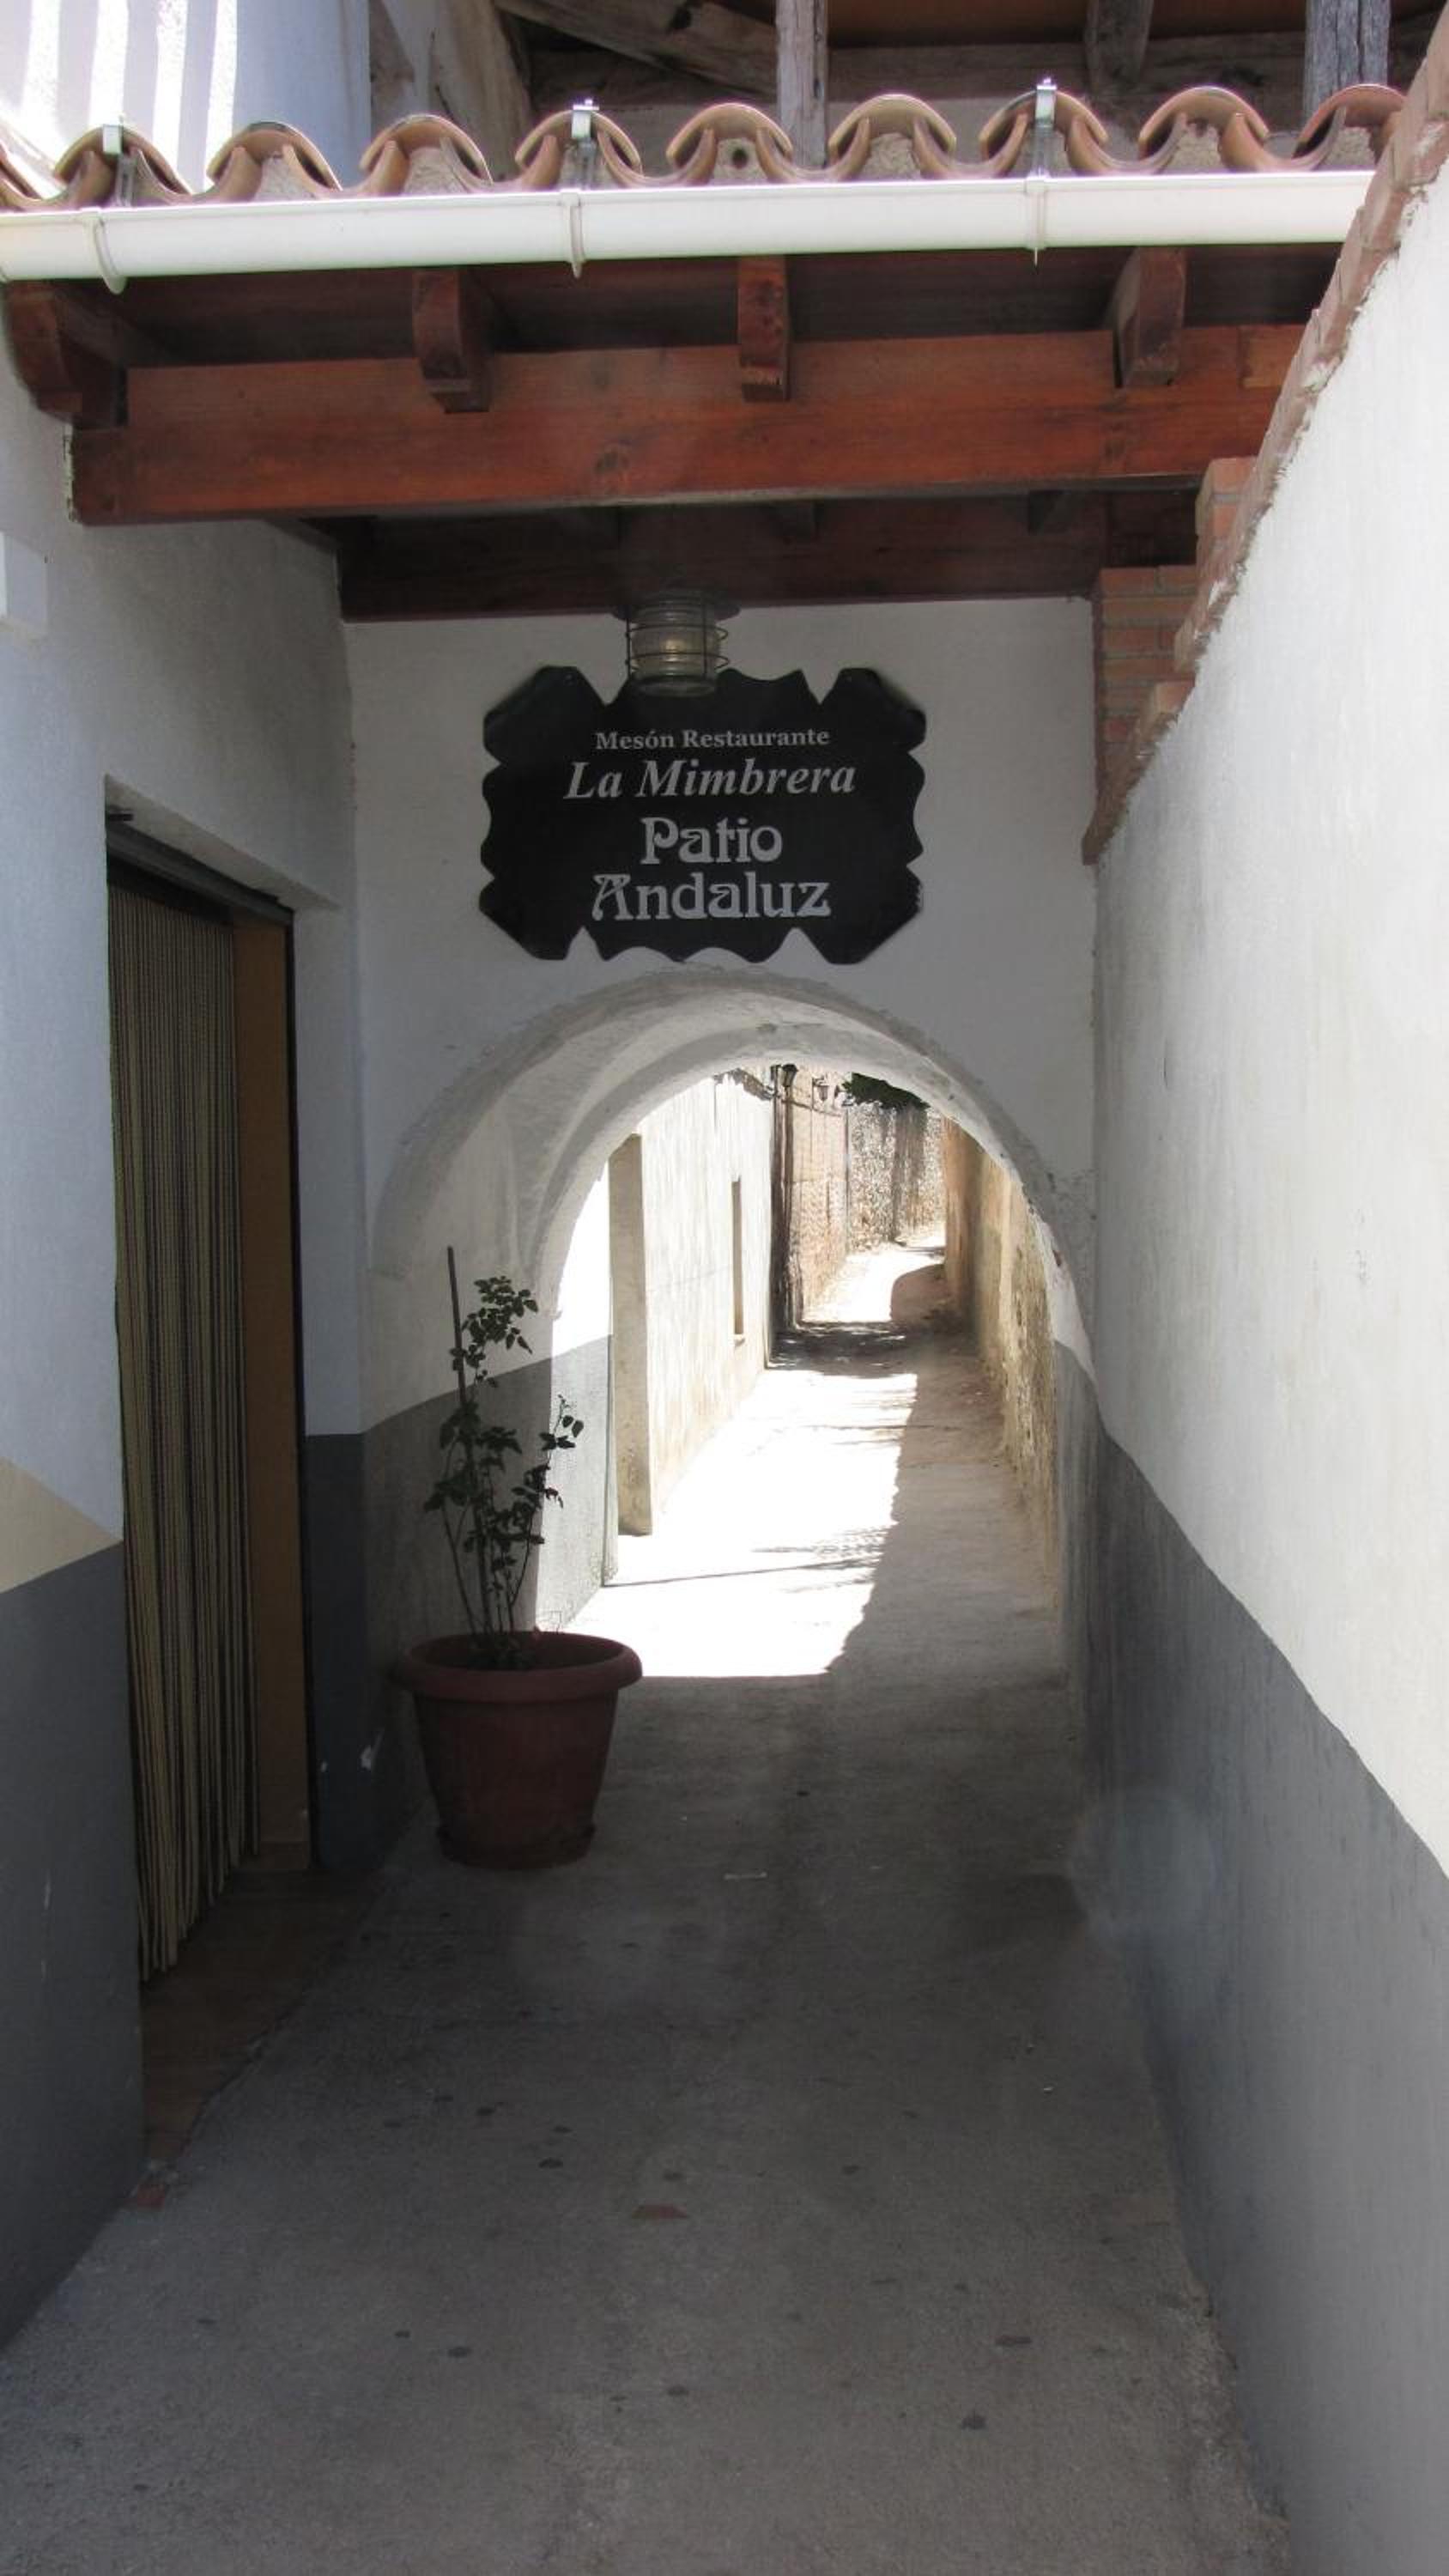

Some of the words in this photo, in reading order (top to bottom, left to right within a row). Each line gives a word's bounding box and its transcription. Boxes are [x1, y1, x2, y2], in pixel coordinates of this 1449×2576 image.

[596, 730, 674, 750] Mesón
[682, 729, 830, 748] Restaurante
[563, 762, 622, 799] La
[637, 758, 856, 798] Mimbrera
[640, 817, 783, 864] Patio
[592, 872, 831, 920] Andaluz
